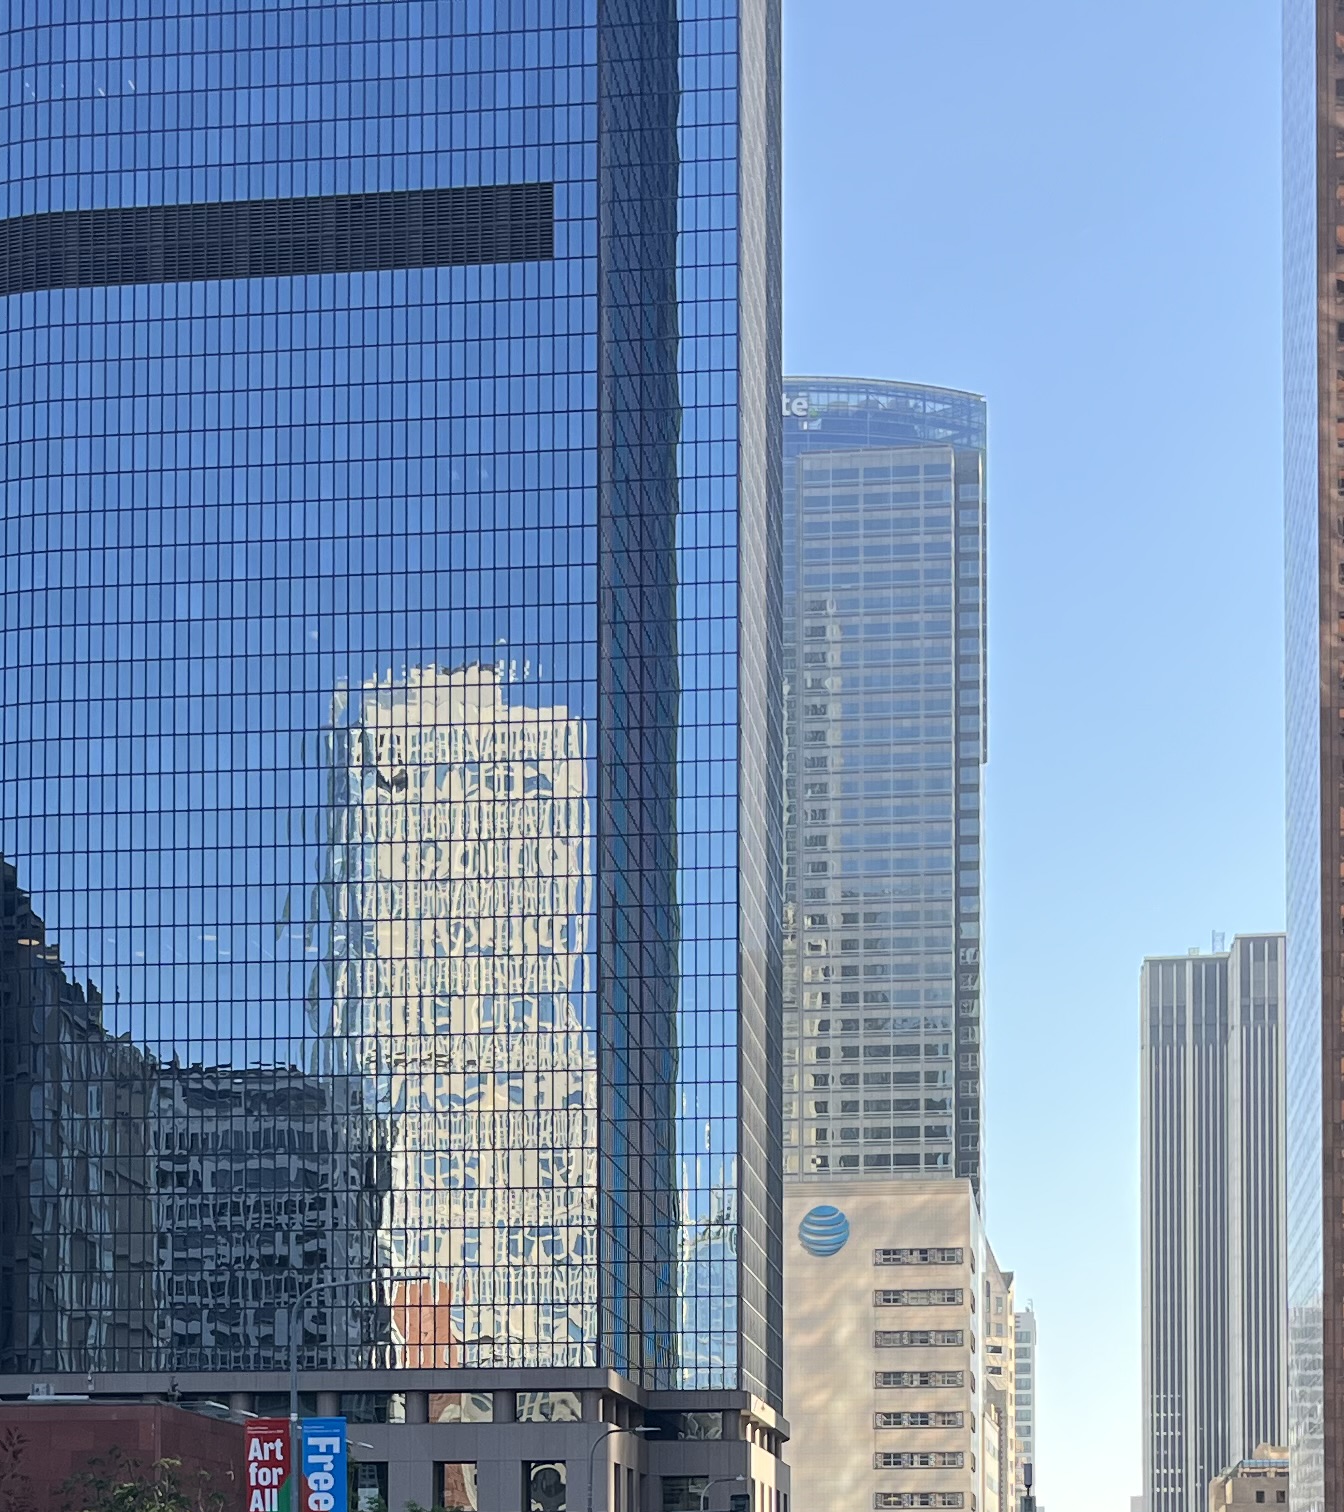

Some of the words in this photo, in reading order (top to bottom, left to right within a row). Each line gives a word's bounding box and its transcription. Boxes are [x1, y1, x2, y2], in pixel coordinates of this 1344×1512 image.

[248, 1438, 284, 1461] Art
[249, 1462, 284, 1486] for
[307, 1437, 341, 1512] Free
[249, 1488, 279, 1512] All
